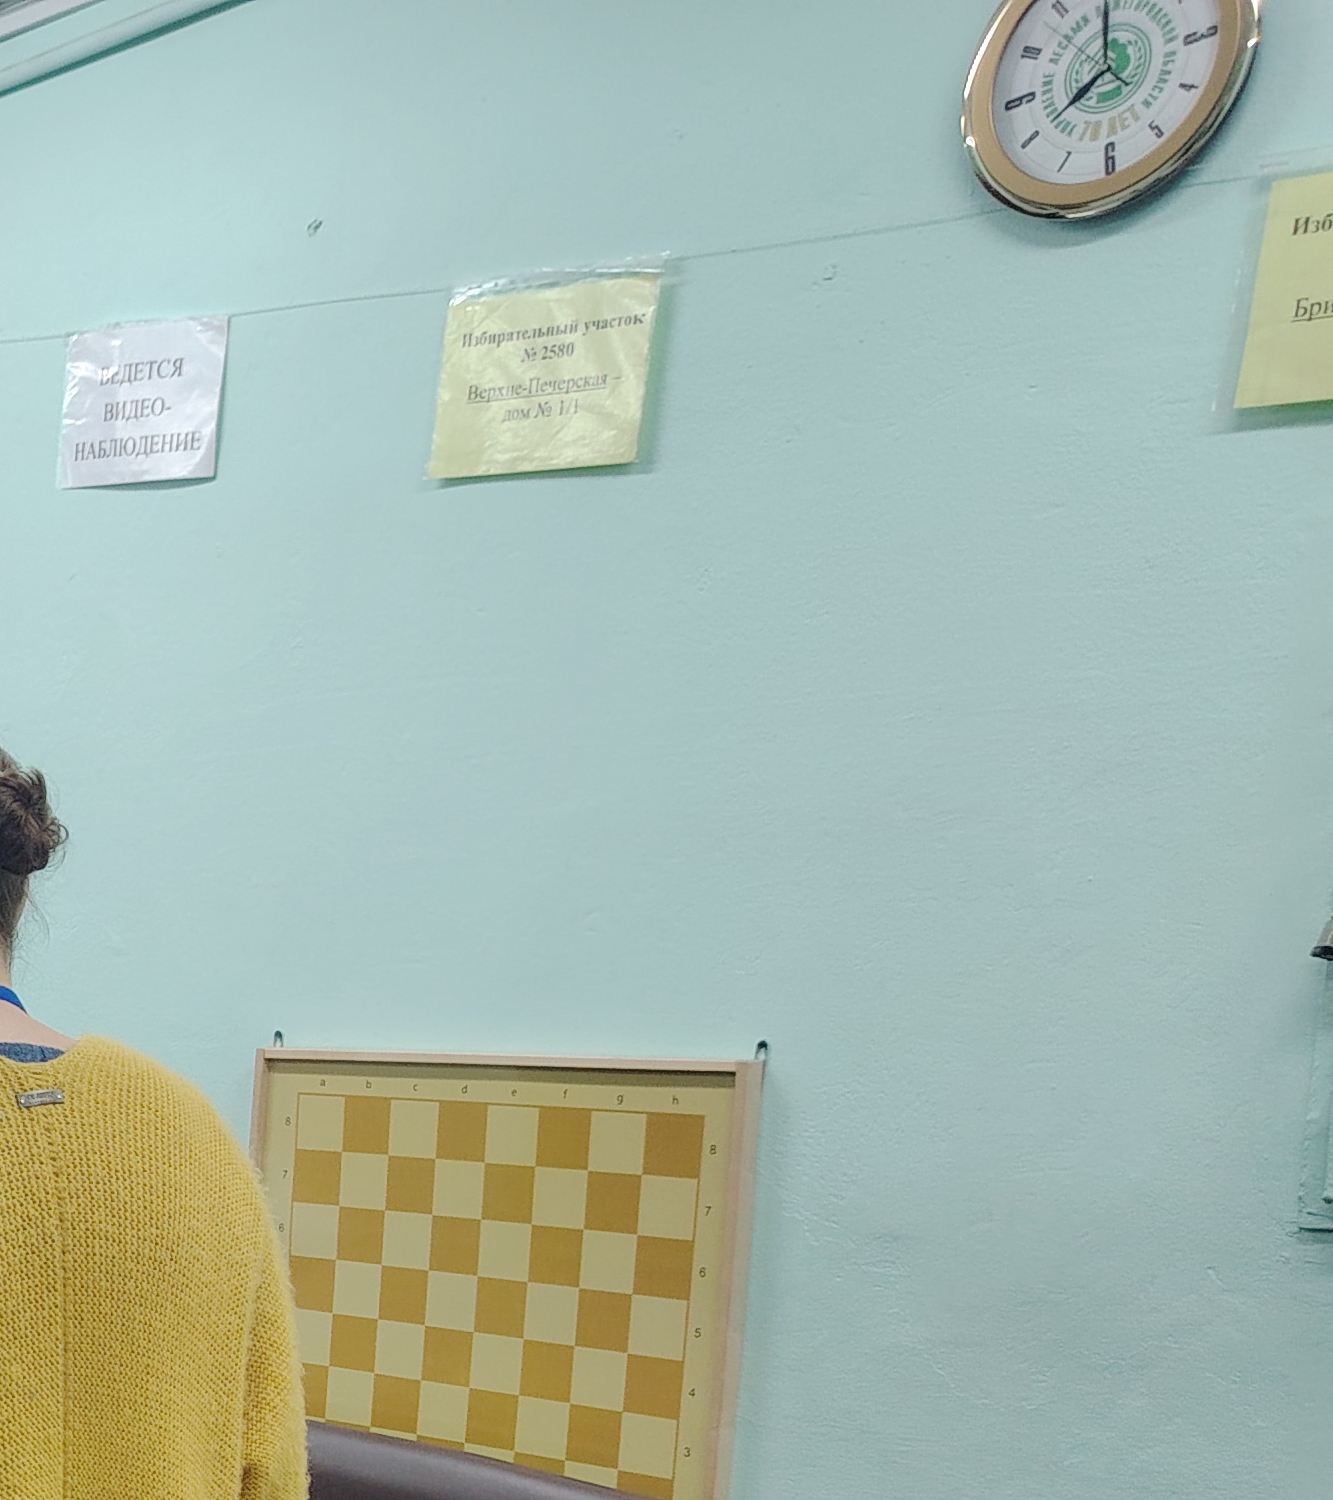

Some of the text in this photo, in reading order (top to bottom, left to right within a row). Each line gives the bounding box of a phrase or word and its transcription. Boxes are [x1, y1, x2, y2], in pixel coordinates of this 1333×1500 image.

[1183, 25, 1218, 46] 3
[1021, 45, 1042, 60] 10
[1179, 82, 1199, 92] 4
[1005, 92, 1036, 111] 9
[1106, 104, 1141, 139] ЛЕТ
[1148, 120, 1165, 138] 5
[1021, 130, 1039, 150] 8
[1057, 151, 1072, 173] 7
[1104, 142, 1116, 176] 6
[462, 313, 647, 348] Избирательный участок
[520, 342, 574, 363] № 2580
[99, 357, 185, 387] ВЕДЕТСЯ
[466, 373, 608, 404] Верхне-Печерская
[103, 397, 172, 423] ВИДЕО-
[502, 398, 580, 423] дом № 1/1
[74, 430, 202, 462] НАБЛЮДЕНИЕ
[320, 1078, 679, 1105] a b c d e f g h
[285, 1116, 291, 1126] 8
[709, 1144, 717, 1155] 8
[282, 1170, 288, 1179] 7
[705, 1206, 712, 1216] 7
[278, 1222, 285, 1232] 6
[699, 1267, 706, 1278] 6
[694, 1328, 701, 1338] 5
[688, 1388, 695, 1397] 4
[683, 1446, 691, 1458] 3
